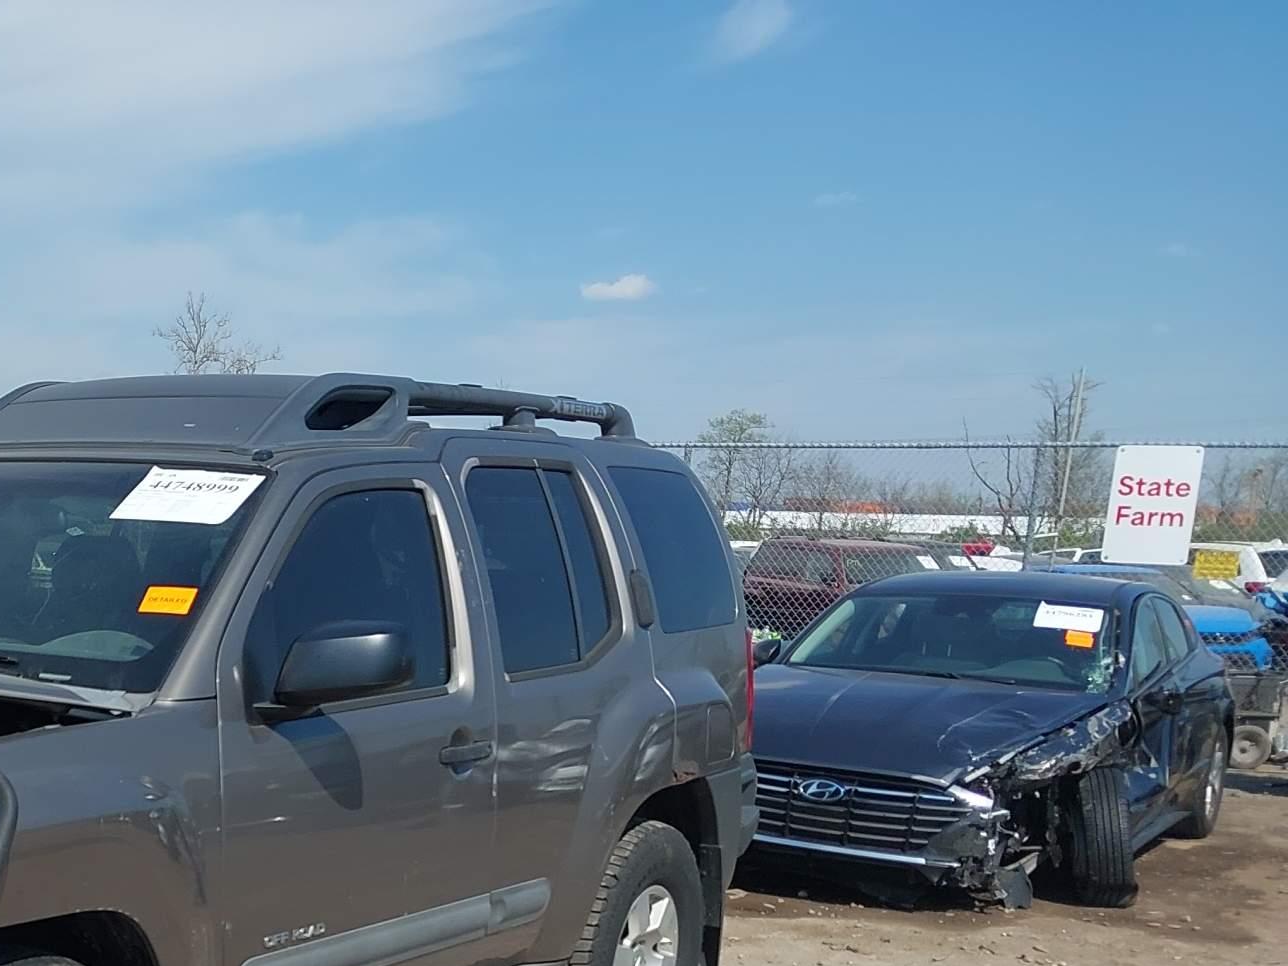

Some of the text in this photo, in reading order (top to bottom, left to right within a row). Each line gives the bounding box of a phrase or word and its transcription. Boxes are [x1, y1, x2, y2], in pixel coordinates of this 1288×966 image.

[149, 480, 240, 493] 44748999
[1117, 475, 1191, 498] State
[1115, 505, 1184, 527] Farm
